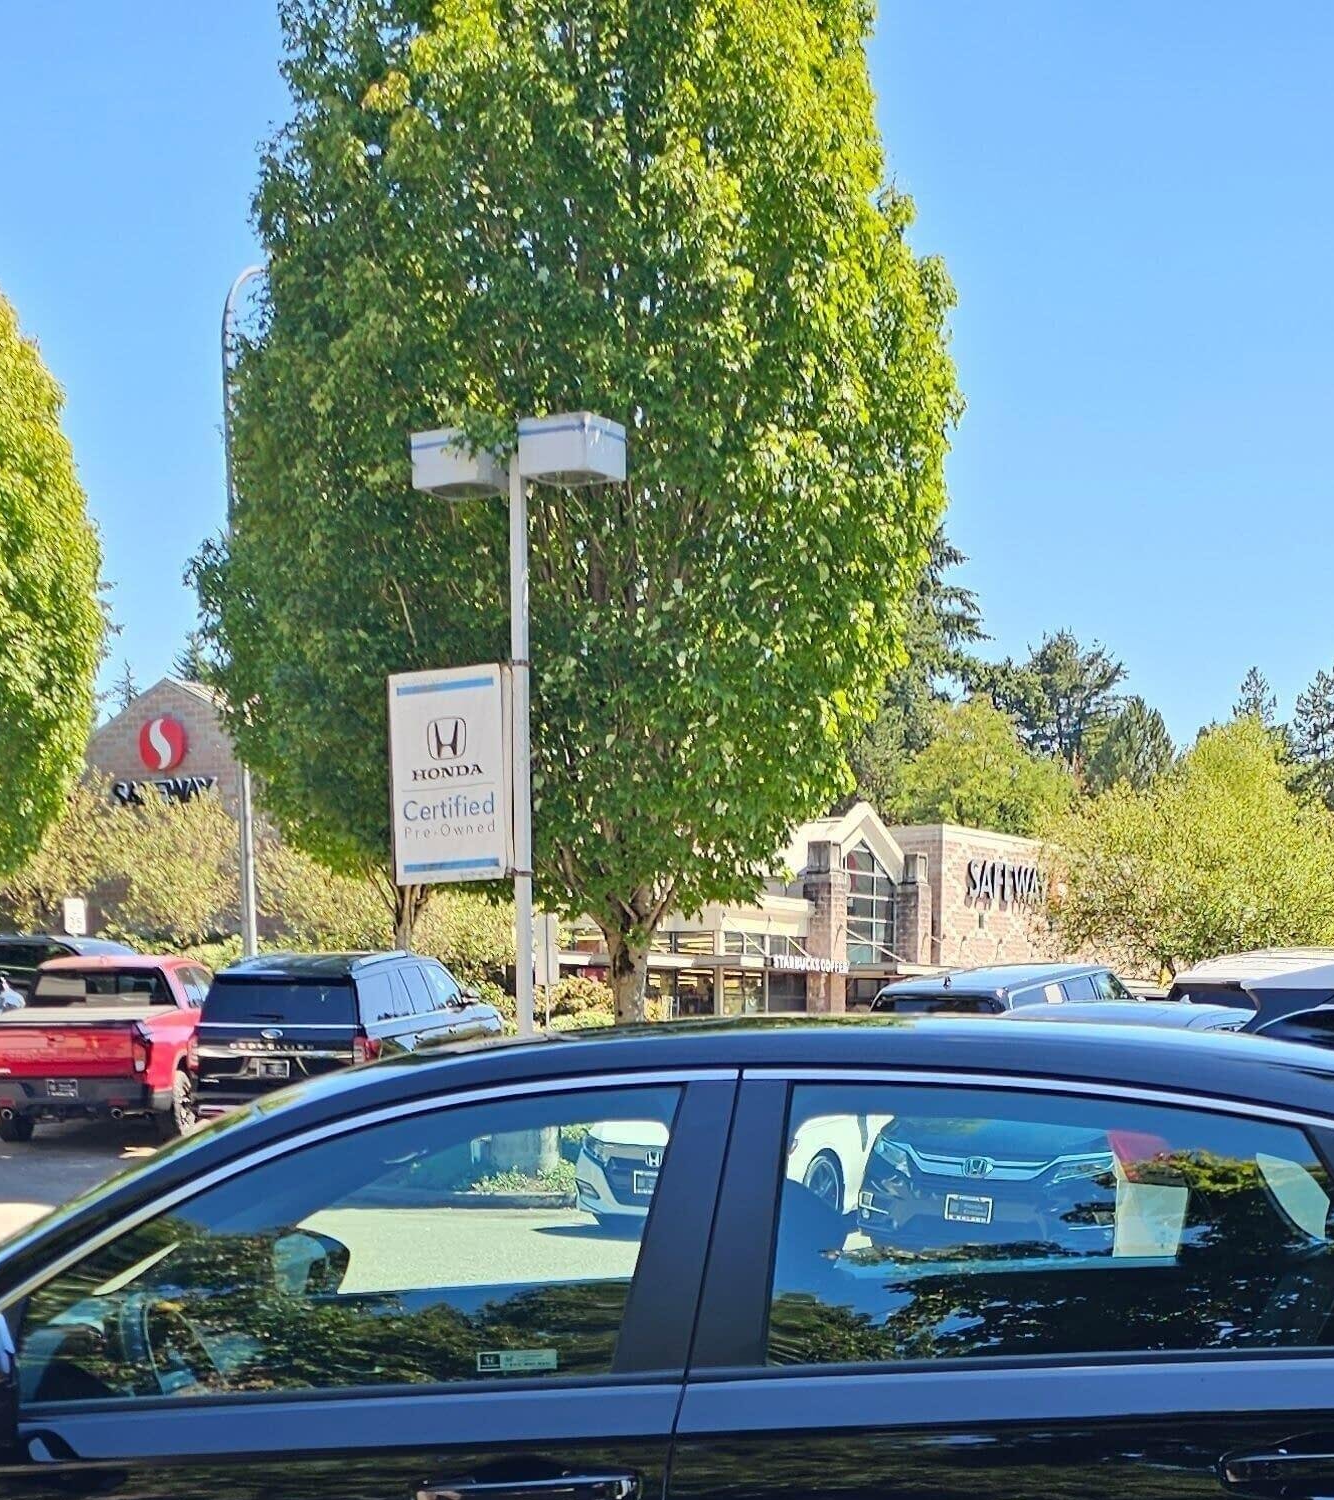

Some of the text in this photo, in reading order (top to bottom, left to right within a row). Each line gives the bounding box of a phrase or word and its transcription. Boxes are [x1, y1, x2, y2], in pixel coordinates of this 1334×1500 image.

[412, 764, 483, 782] HONDA
[403, 791, 495, 822] Certified
[404, 819, 496, 840] Pre-Owned
[773, 954, 820, 972] STARBUCKS
